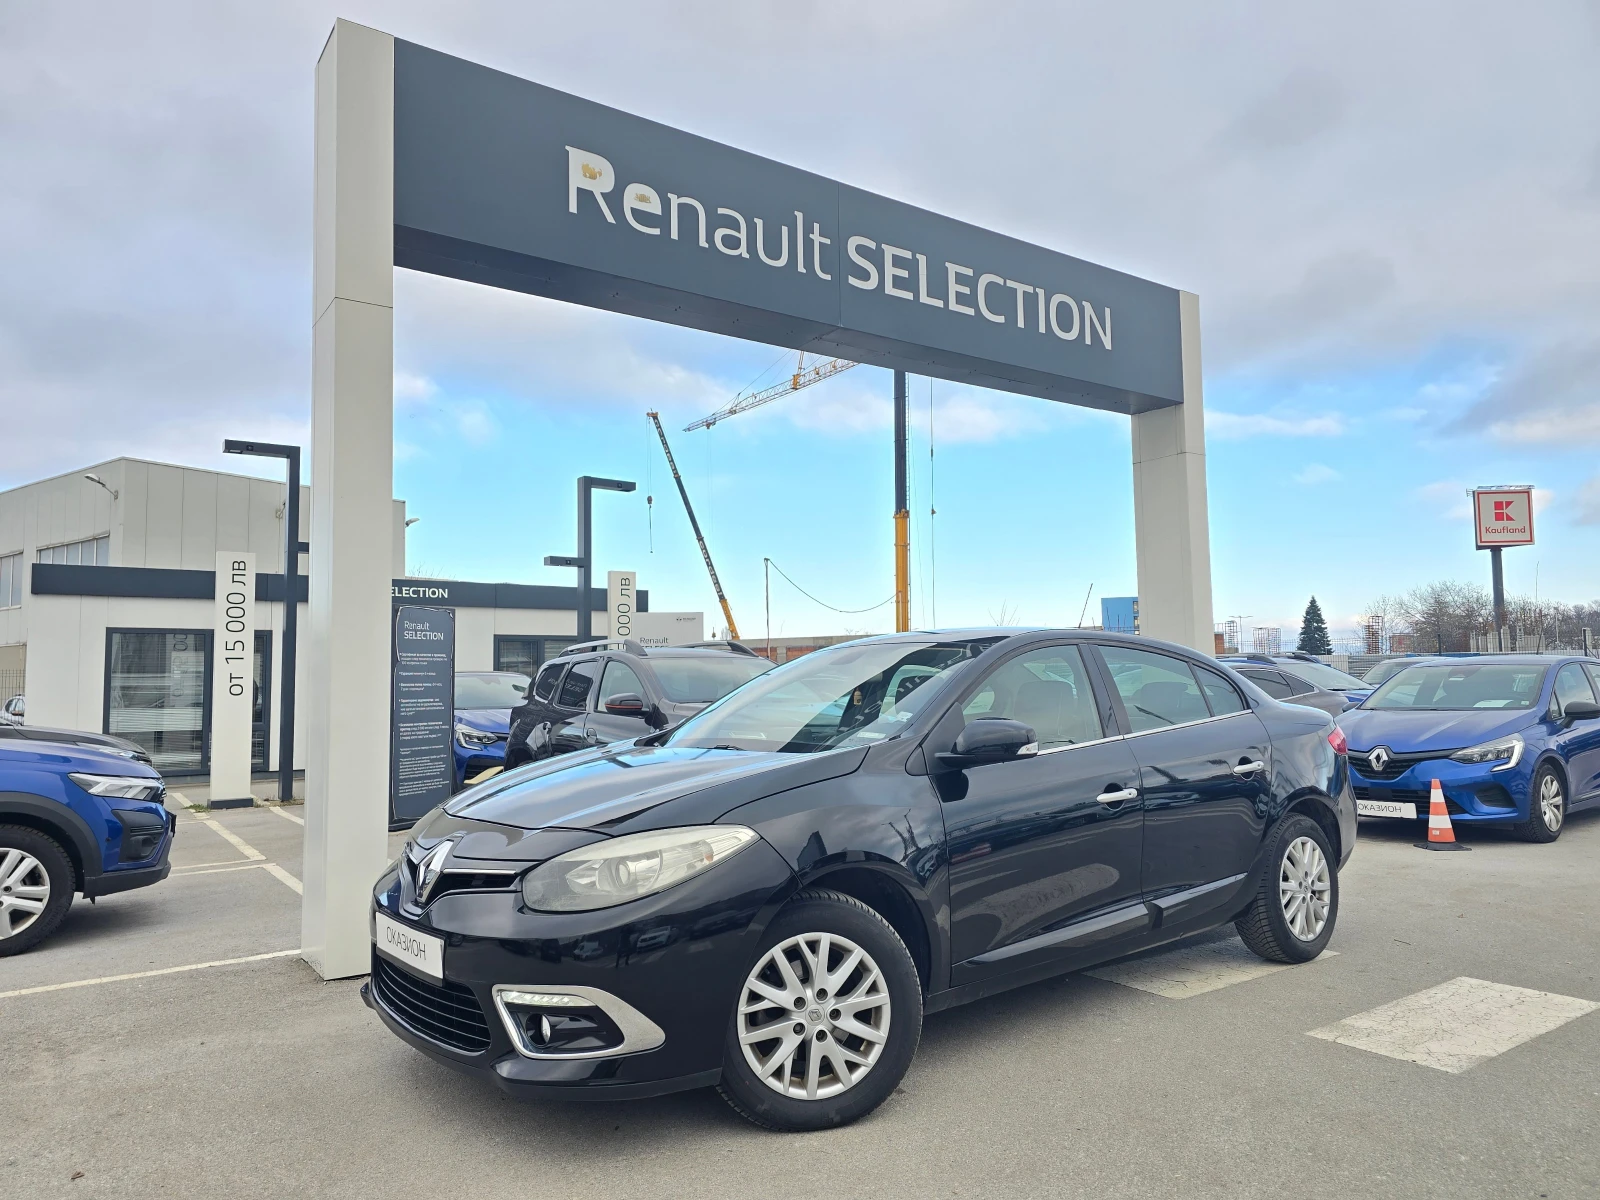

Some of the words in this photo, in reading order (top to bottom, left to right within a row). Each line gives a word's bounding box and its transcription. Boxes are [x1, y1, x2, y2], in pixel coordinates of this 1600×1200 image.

[564, 145, 832, 282] Renault
[847, 235, 1113, 350] SELECTION
[1485, 525, 1526, 534] Kaufland
[225, 592, 246, 633] 000
[617, 603, 631, 636] 000
[404, 620, 430, 631] Renault
[403, 630, 444, 641] SELECTION
[639, 636, 669, 645] Renault
[225, 640, 245, 664] 15
[1358, 803, 1402, 813] ОКАЗИОН
[386, 926, 427, 961] ОКАЗИОН
